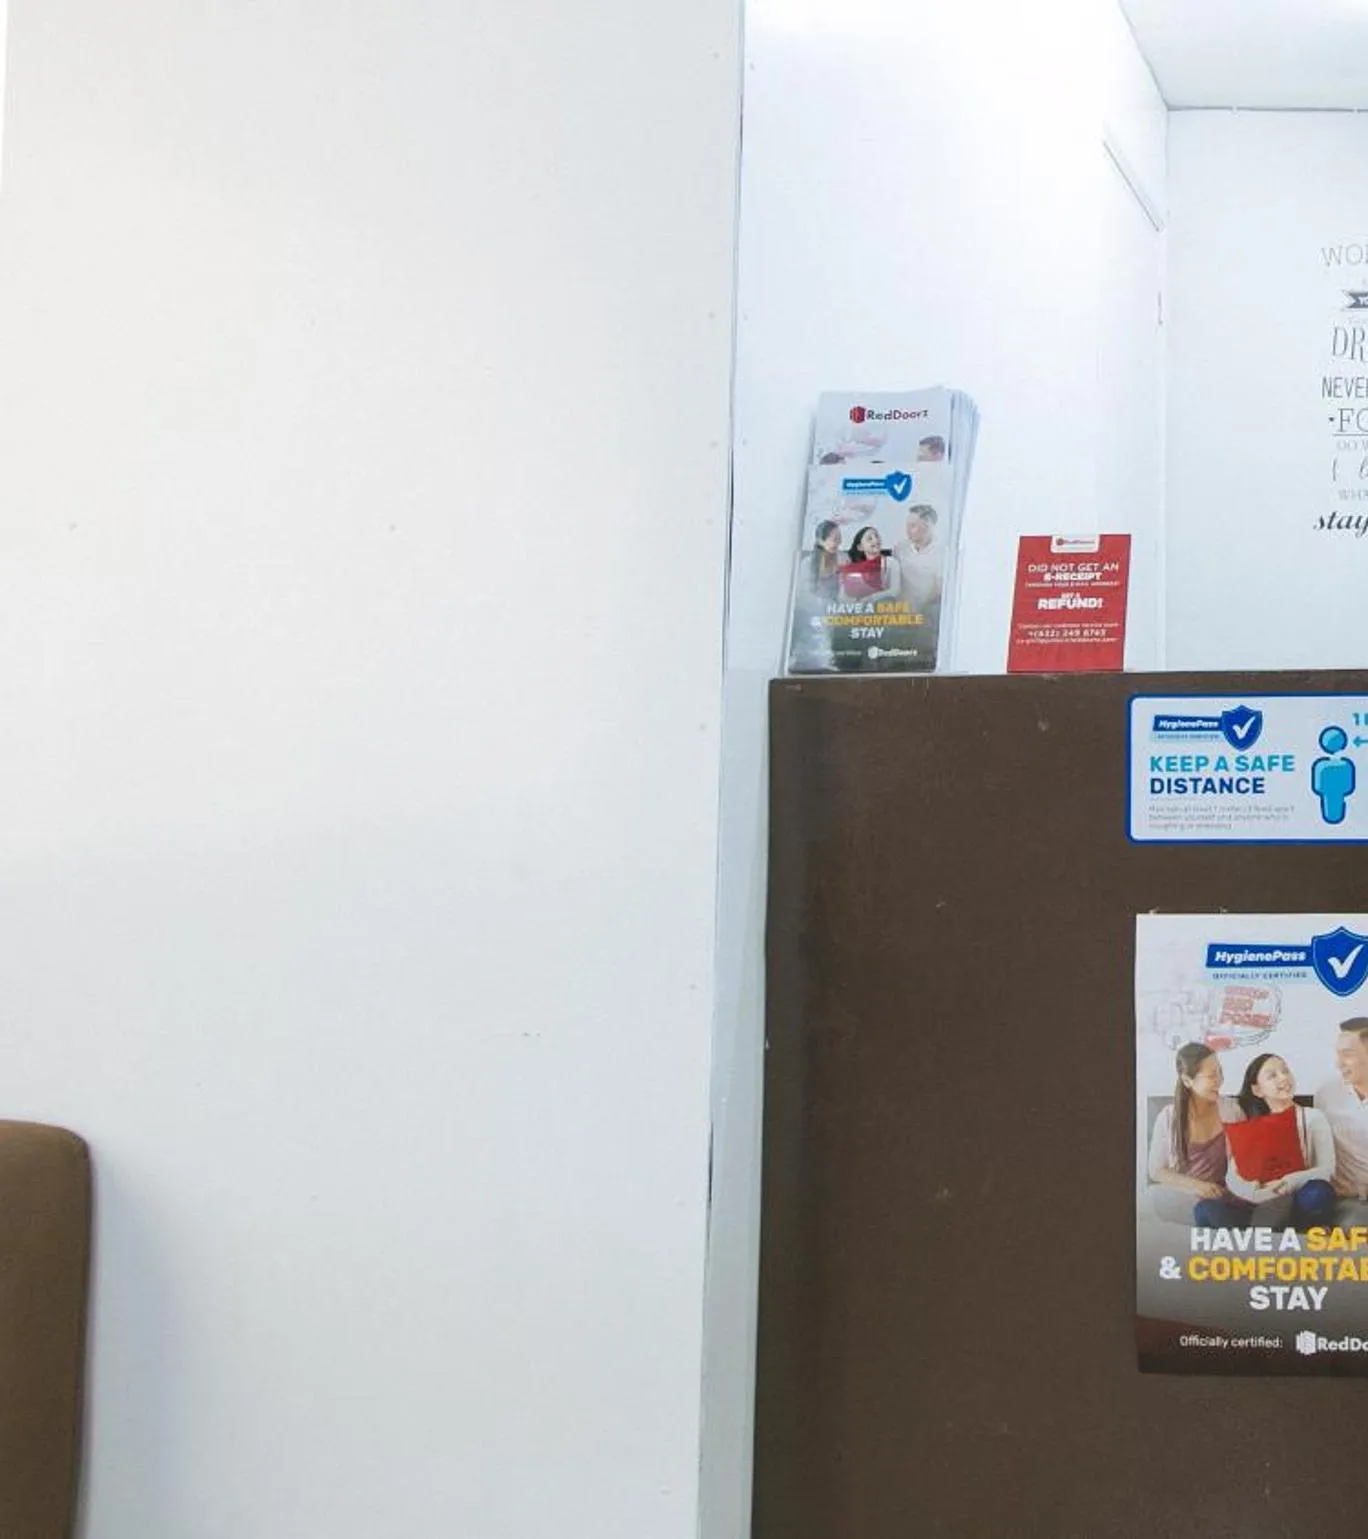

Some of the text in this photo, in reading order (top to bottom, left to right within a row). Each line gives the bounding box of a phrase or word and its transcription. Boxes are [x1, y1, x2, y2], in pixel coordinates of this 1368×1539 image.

[866, 409, 929, 421] RedDoorz
[1051, 563, 1075, 572] NOT
[1078, 562, 1099, 572] GET
[1103, 561, 1120, 572] AN
[826, 602, 862, 614] HAVE
[863, 603, 874, 613] A
[1037, 598, 1104, 610] REFUND!
[850, 627, 885, 640] STAY
[1150, 755, 1295, 772] KEEP A SAFE
[1150, 777, 1266, 795] DISTANCE
[1214, 949, 1308, 964] HygienePass
[1190, 1227, 1272, 1251] HAVE
[1278, 1227, 1301, 1251] A
[1159, 1256, 1182, 1280] &
[1249, 1286, 1328, 1311] STAY
[1179, 1336, 1229, 1350] Officially
[1230, 1336, 1283, 1349] certified:
